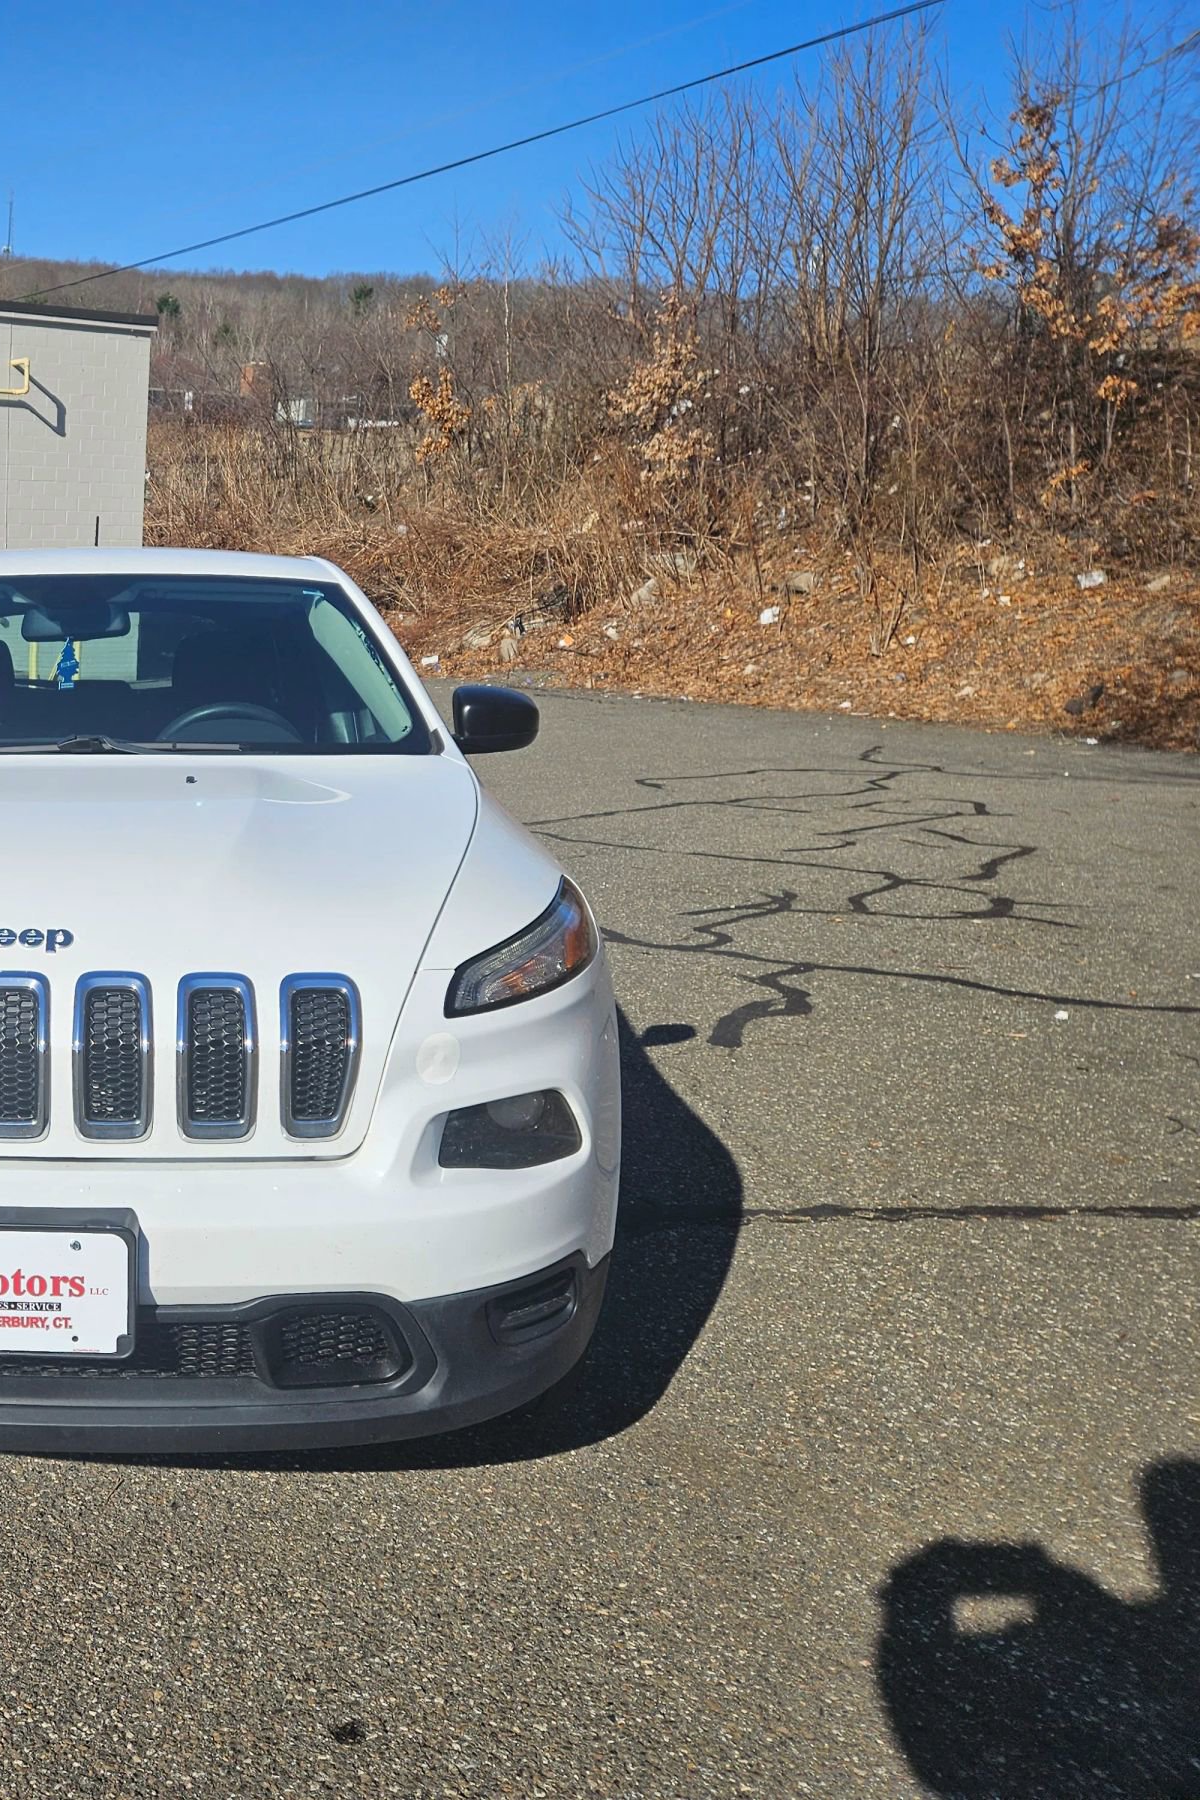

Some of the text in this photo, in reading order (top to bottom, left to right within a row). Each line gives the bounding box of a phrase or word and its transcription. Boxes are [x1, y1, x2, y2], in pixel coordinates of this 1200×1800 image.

[89, 1287, 110, 1296] LLC
[16, 1301, 61, 1312] SERVICE
[52, 1316, 73, 1329] CT.
